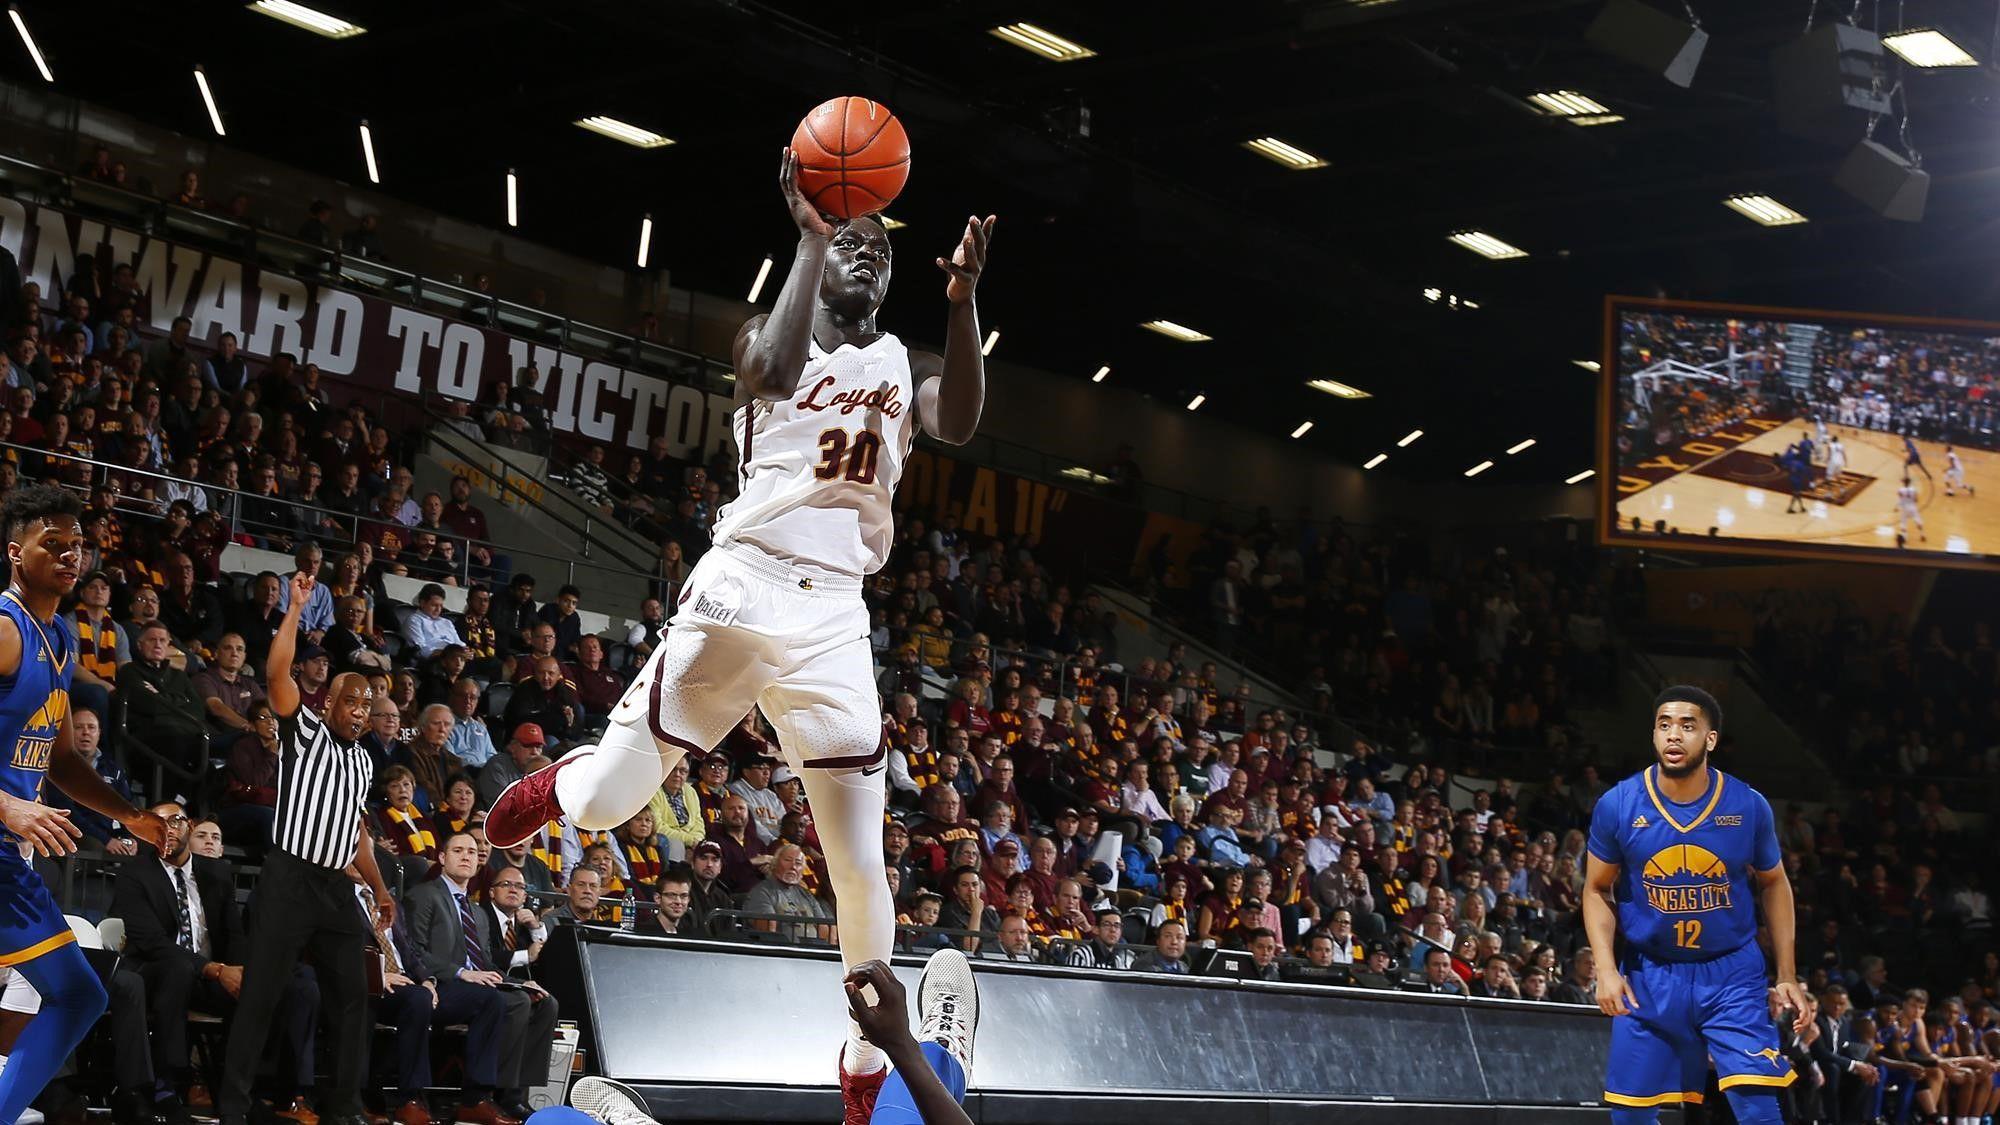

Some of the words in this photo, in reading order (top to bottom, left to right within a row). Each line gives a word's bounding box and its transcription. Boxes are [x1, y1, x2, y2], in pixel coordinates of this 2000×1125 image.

[387, 305, 485, 401] TO
[796, 375, 903, 419] Loyola
[813, 426, 880, 486] 30
[695, 594, 736, 623] VALLEY
[1714, 815, 1742, 826] WAC
[1700, 885, 1731, 909] CITY
[1673, 920, 1702, 949] 12
